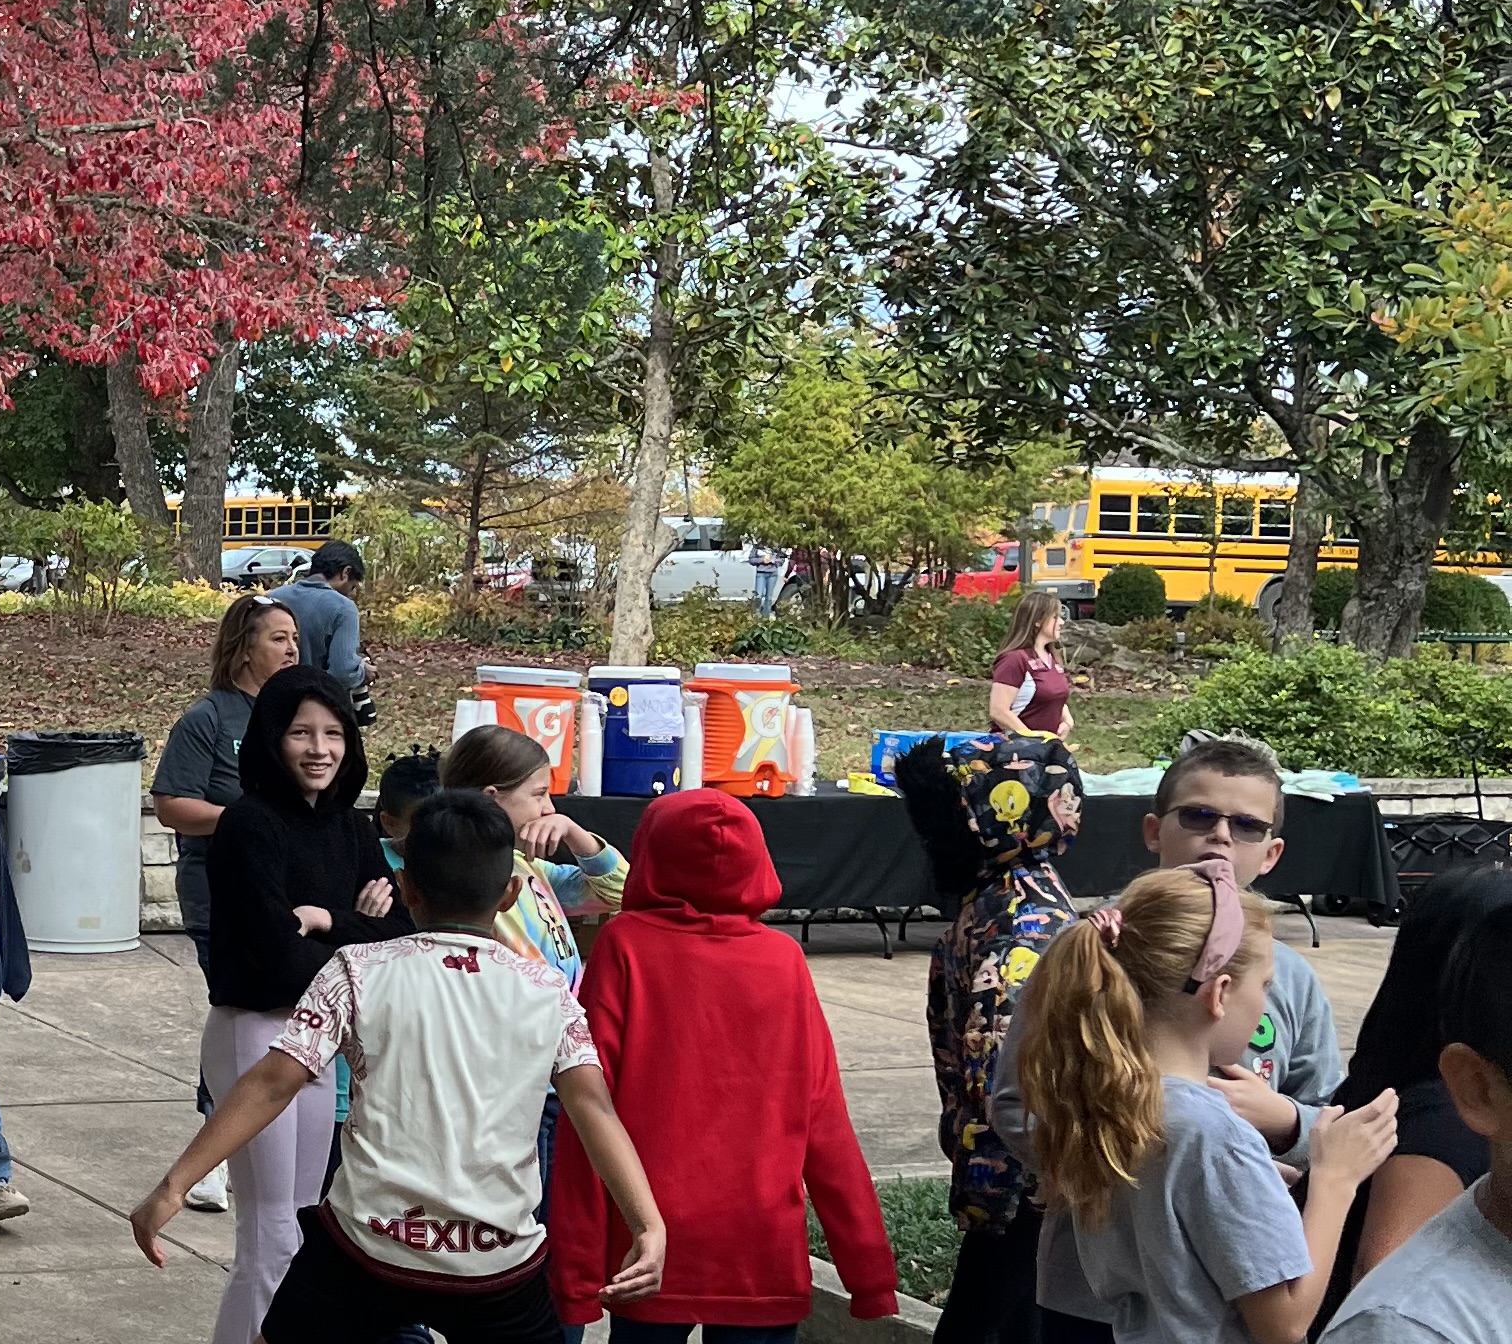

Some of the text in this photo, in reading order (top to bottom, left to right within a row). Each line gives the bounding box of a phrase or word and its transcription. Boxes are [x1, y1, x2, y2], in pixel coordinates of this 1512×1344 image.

[535, 705, 561, 737] G
[751, 697, 783, 738] G
[367, 1205, 518, 1252] MÉXICO
